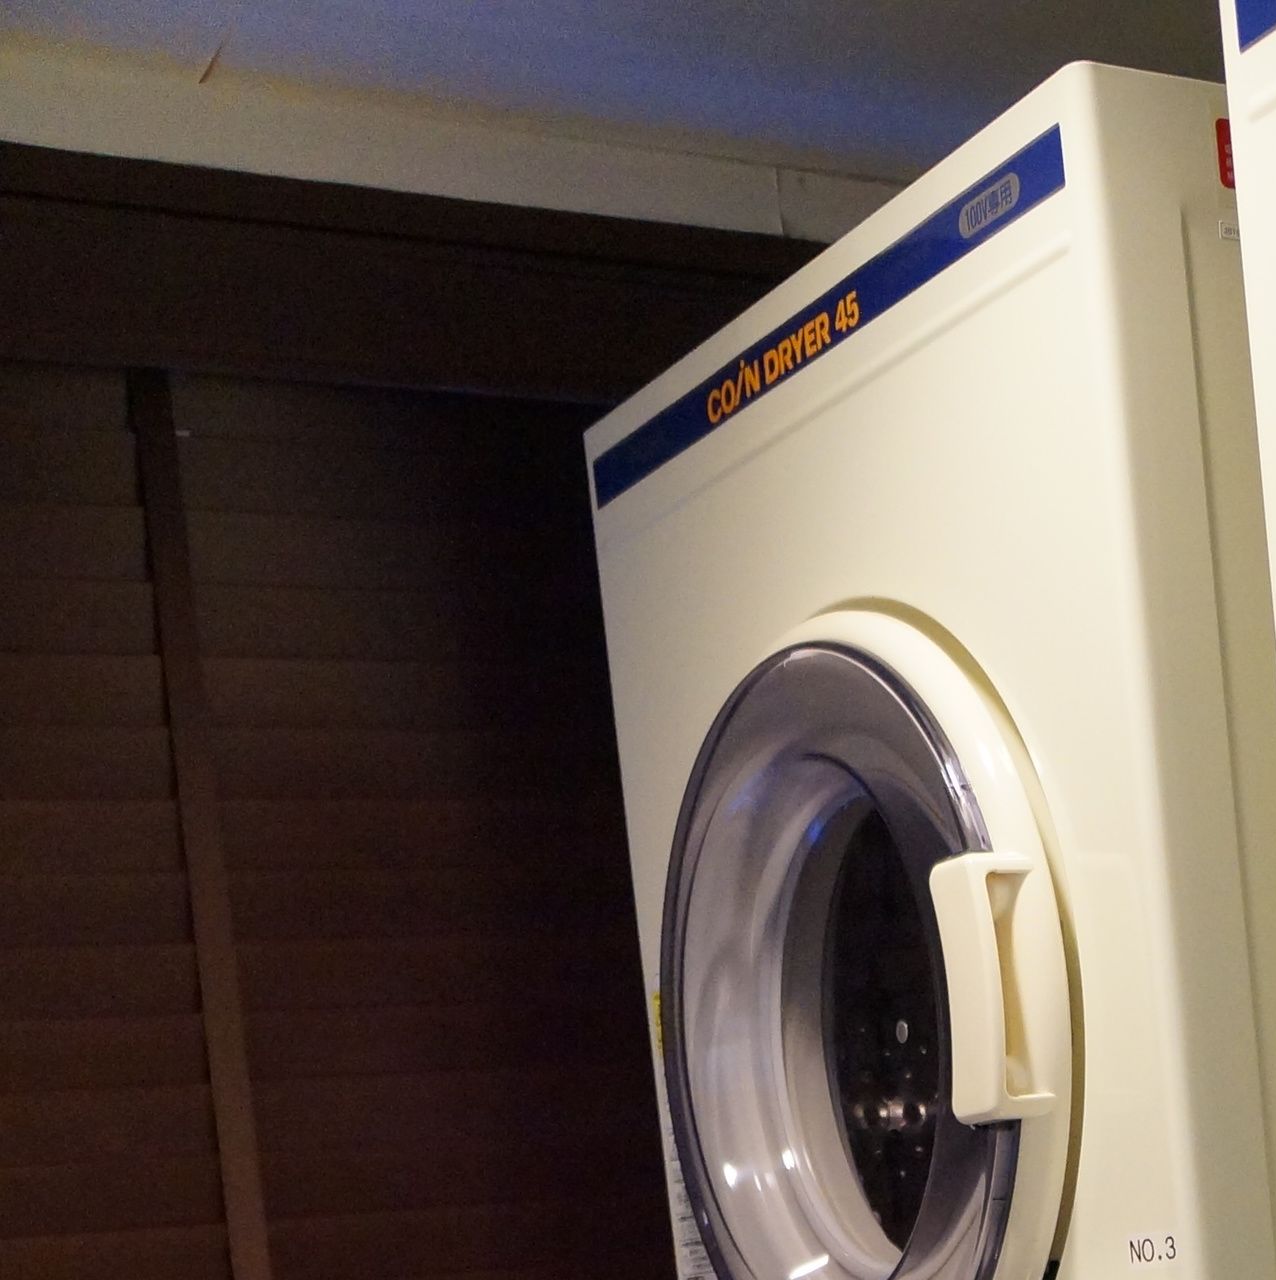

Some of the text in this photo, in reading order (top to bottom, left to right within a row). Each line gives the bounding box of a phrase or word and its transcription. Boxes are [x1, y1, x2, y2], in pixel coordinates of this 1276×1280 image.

[707, 290, 860, 423] COIN DRYER 45
[1130, 1236, 1176, 1264] NO.3
